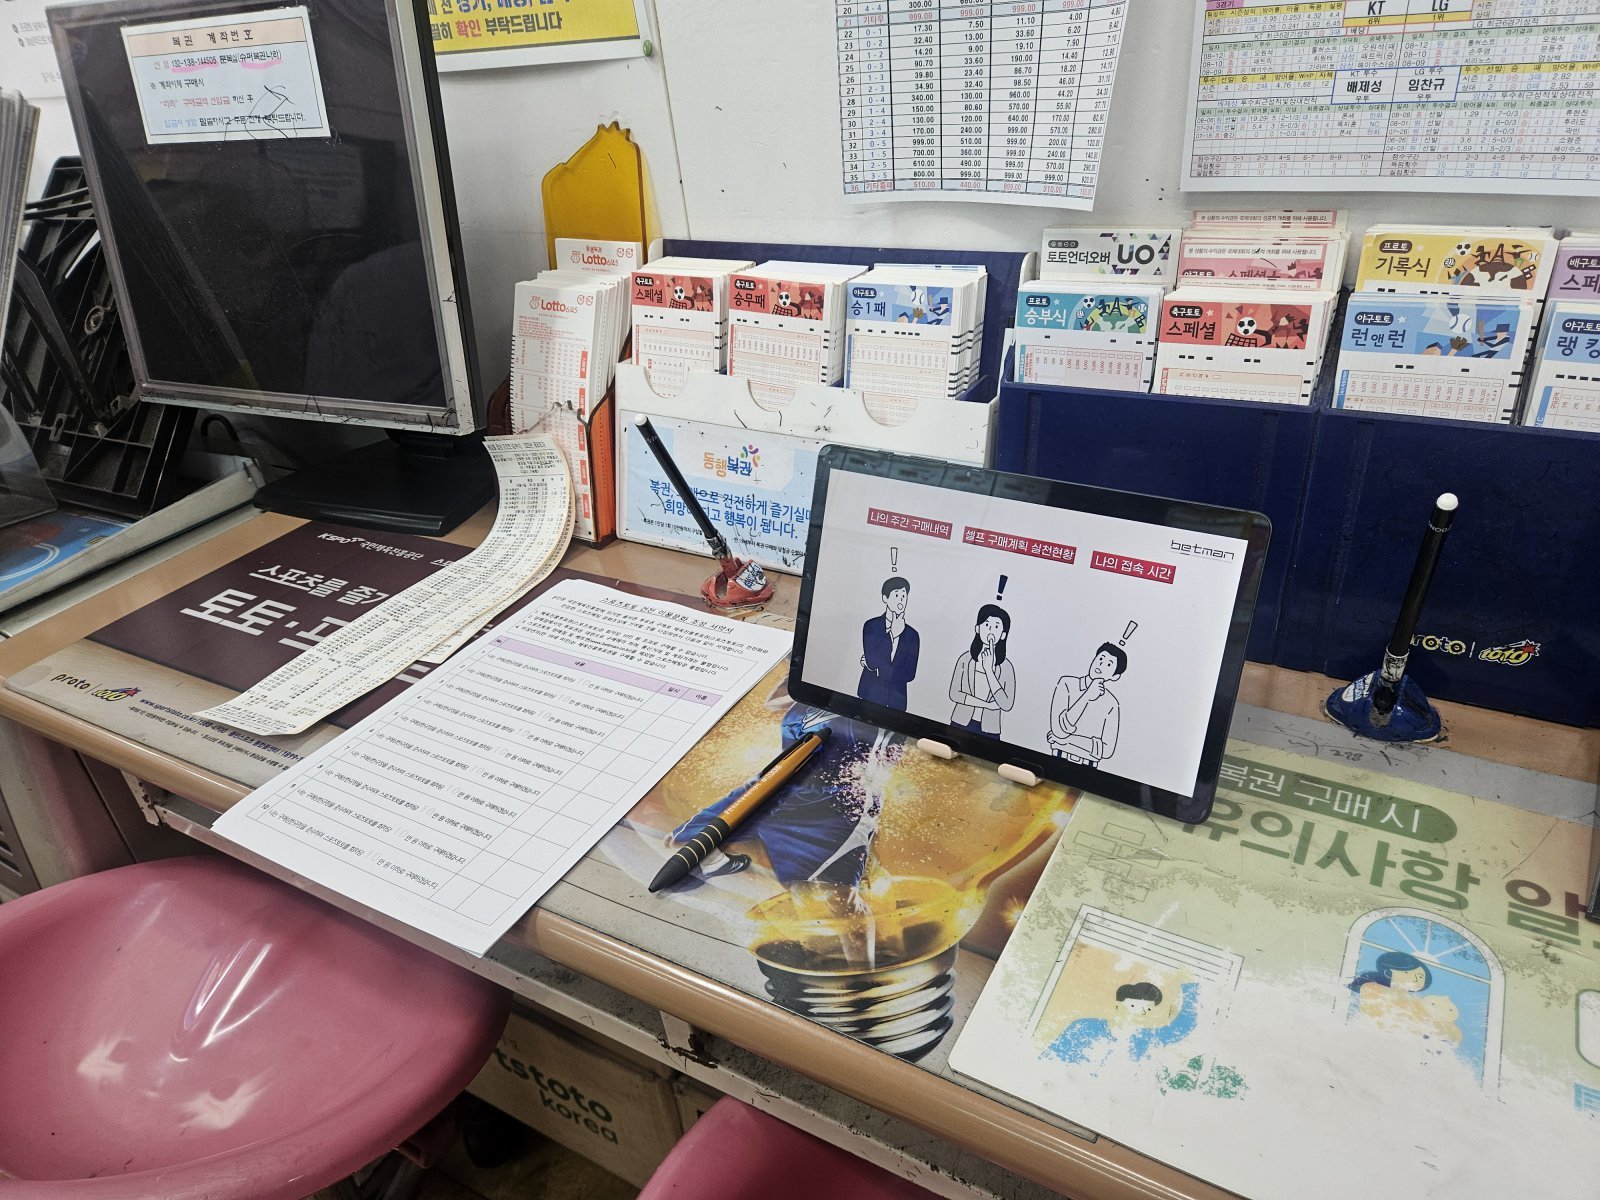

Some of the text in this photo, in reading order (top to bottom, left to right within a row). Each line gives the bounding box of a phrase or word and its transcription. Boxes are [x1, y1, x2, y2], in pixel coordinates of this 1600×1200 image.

[909, 12, 933, 21] 999.00
[960, 8, 984, 17] 999.00
[1012, 3, 1035, 13] 999.00
[1367, 0, 1386, 16] KT
[1431, 0, 1449, 12] LG
[455, 19, 482, 38] 확인
[485, 11, 562, 36] 부탁드립니다
[914, 24, 933, 32] 17.30
[969, 20, 984, 28] 7.50
[1016, 17, 1035, 25] 11.10
[1069, 12, 1083, 21] 4.00
[913, 36, 933, 44] 32.40
[965, 33, 984, 41] 13.00
[845, 42, 1034, 61] 24 14.20 9.00 19.10
[914, 60, 933, 68] 90.70
[1011, 54, 1033, 62] 190.00
[846, 68, 984, 84] 26 23.40
[1408, 78, 1446, 92] 임찬규
[1346, 80, 1382, 93] 배제성
[847, 91, 983, 106] 28 340.00 130.00
[848, 120, 857, 128] 30
[912, 116, 935, 124] 130.00
[912, 138, 935, 146] 999.00
[1046, 244, 1155, 265] 토토언더오버 UO
[1383, 242, 1408, 251] 프로토
[1375, 256, 1431, 277] 기록식
[635, 288, 663, 304] 스페셜
[733, 291, 765, 309] 승무패
[853, 288, 876, 297] 야구토토
[1027, 296, 1047, 306] 프로토
[1024, 308, 1067, 327] 승부식
[1171, 306, 1201, 317] 축구토토
[1356, 314, 1392, 324] 야구토토
[1166, 321, 1216, 340] 스페셜
[703, 452, 752, 478] 동행복권
[650, 480, 674, 498] 복권,
[723, 493, 768, 516] 건전하게
[724, 510, 758, 531] 행복이
[760, 518, 798, 539] 됩니다.
[869, 511, 950, 537] 나의 주간 구매내역
[316, 532, 351, 544] KSPO
[964, 529, 1075, 563] 셀프 구매계획 실천현황
[1170, 539, 1235, 560] betman
[1094, 553, 1173, 582] 나의 접속 시간
[249, 562, 349, 598] 스포츠를
[601, 596, 637, 608] 스포츠토토
[658, 609, 689, 621] 이용문화
[692, 618, 707, 626] 조성
[710, 623, 734, 633] 서약서
[1410, 634, 1466, 655] roto
[50, 672, 91, 691] proto
[1217, 763, 1420, 833] 복권 구매 시
[1183, 796, 1480, 912] 유의사항
[538, 1089, 619, 1145] korea
